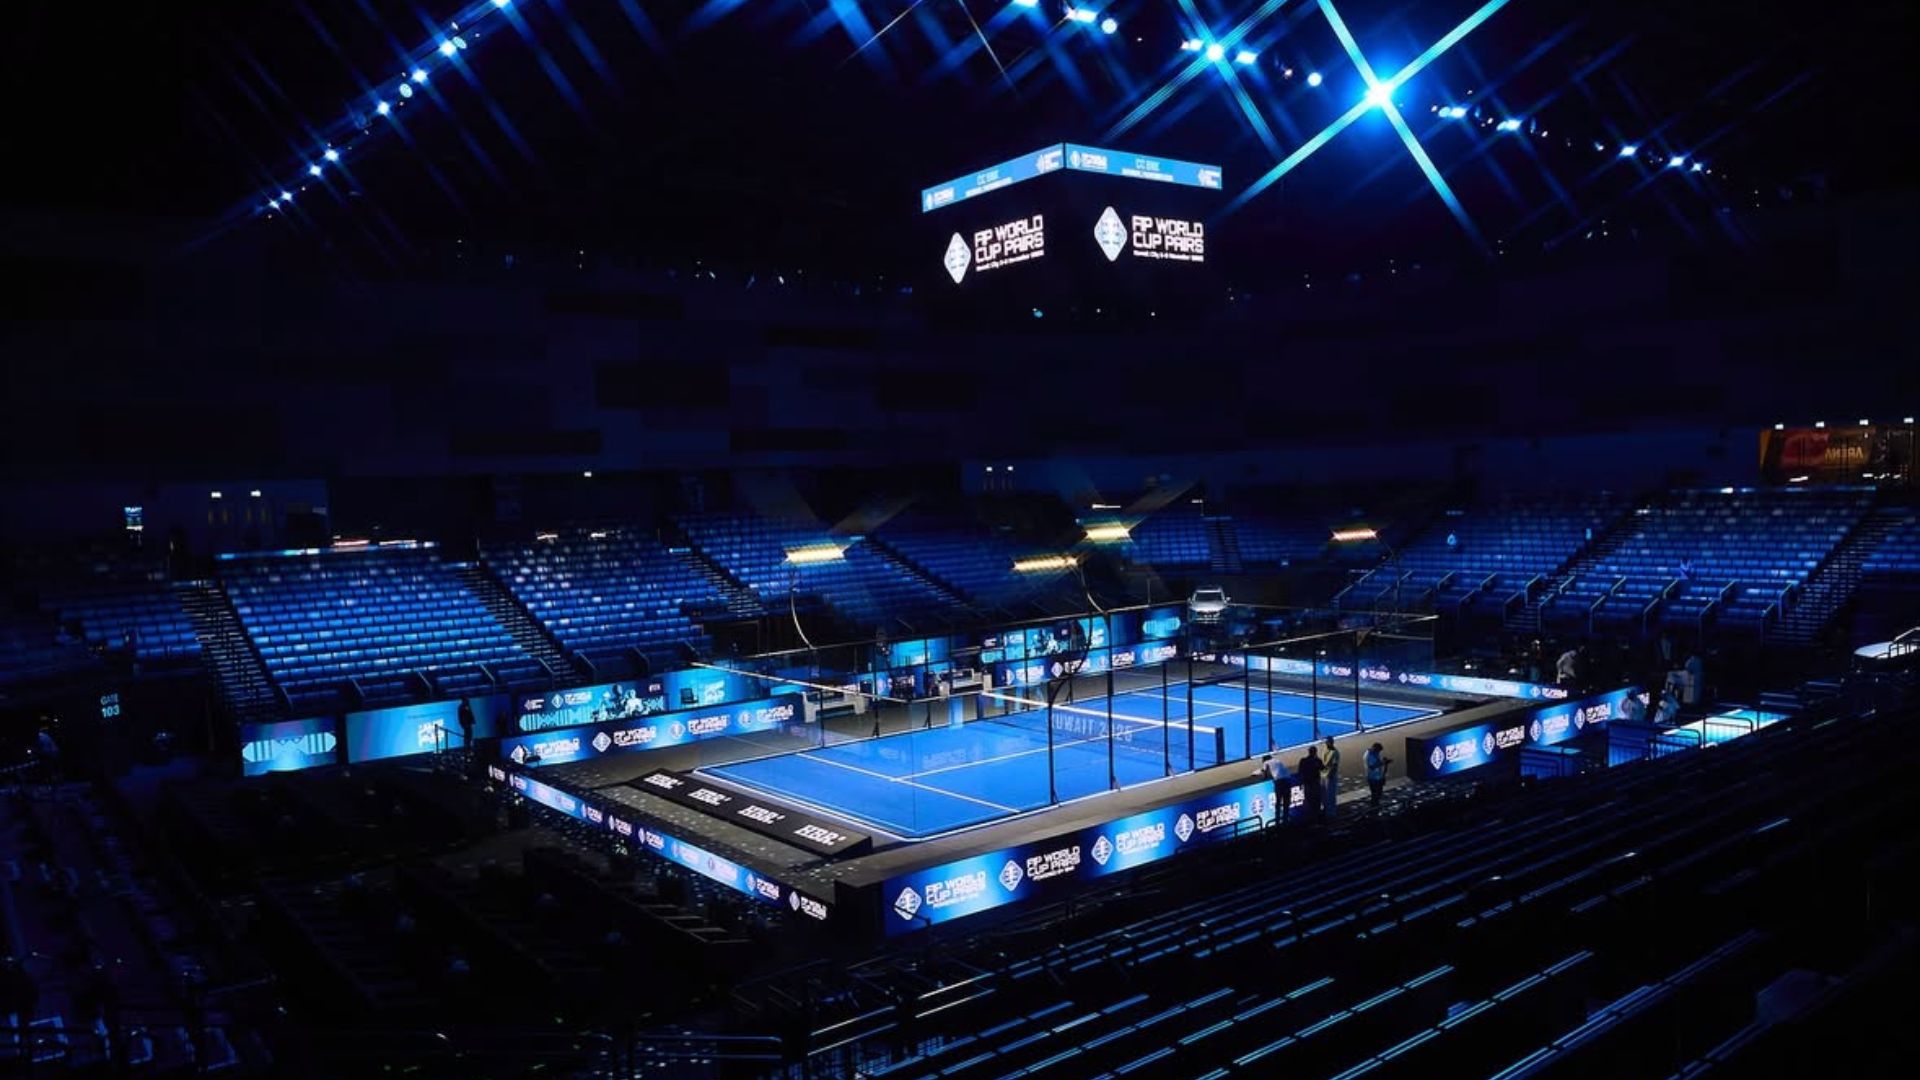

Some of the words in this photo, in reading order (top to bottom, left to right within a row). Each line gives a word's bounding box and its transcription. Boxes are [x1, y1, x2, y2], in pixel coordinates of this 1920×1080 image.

[994, 214, 1043, 241] WORLD
[1155, 217, 1204, 238] WORLD
[975, 243, 1002, 263] CUP
[1004, 231, 1044, 256] PAIRS
[1133, 231, 1162, 250] CUP
[1165, 235, 1204, 254] PAIRS
[102, 704, 120, 718] 103
[1043, 846, 1080, 863] WORLD
[1027, 863, 1049, 877] CUP
[944, 871, 986, 890] WORLD
[926, 889, 951, 905] CUP
